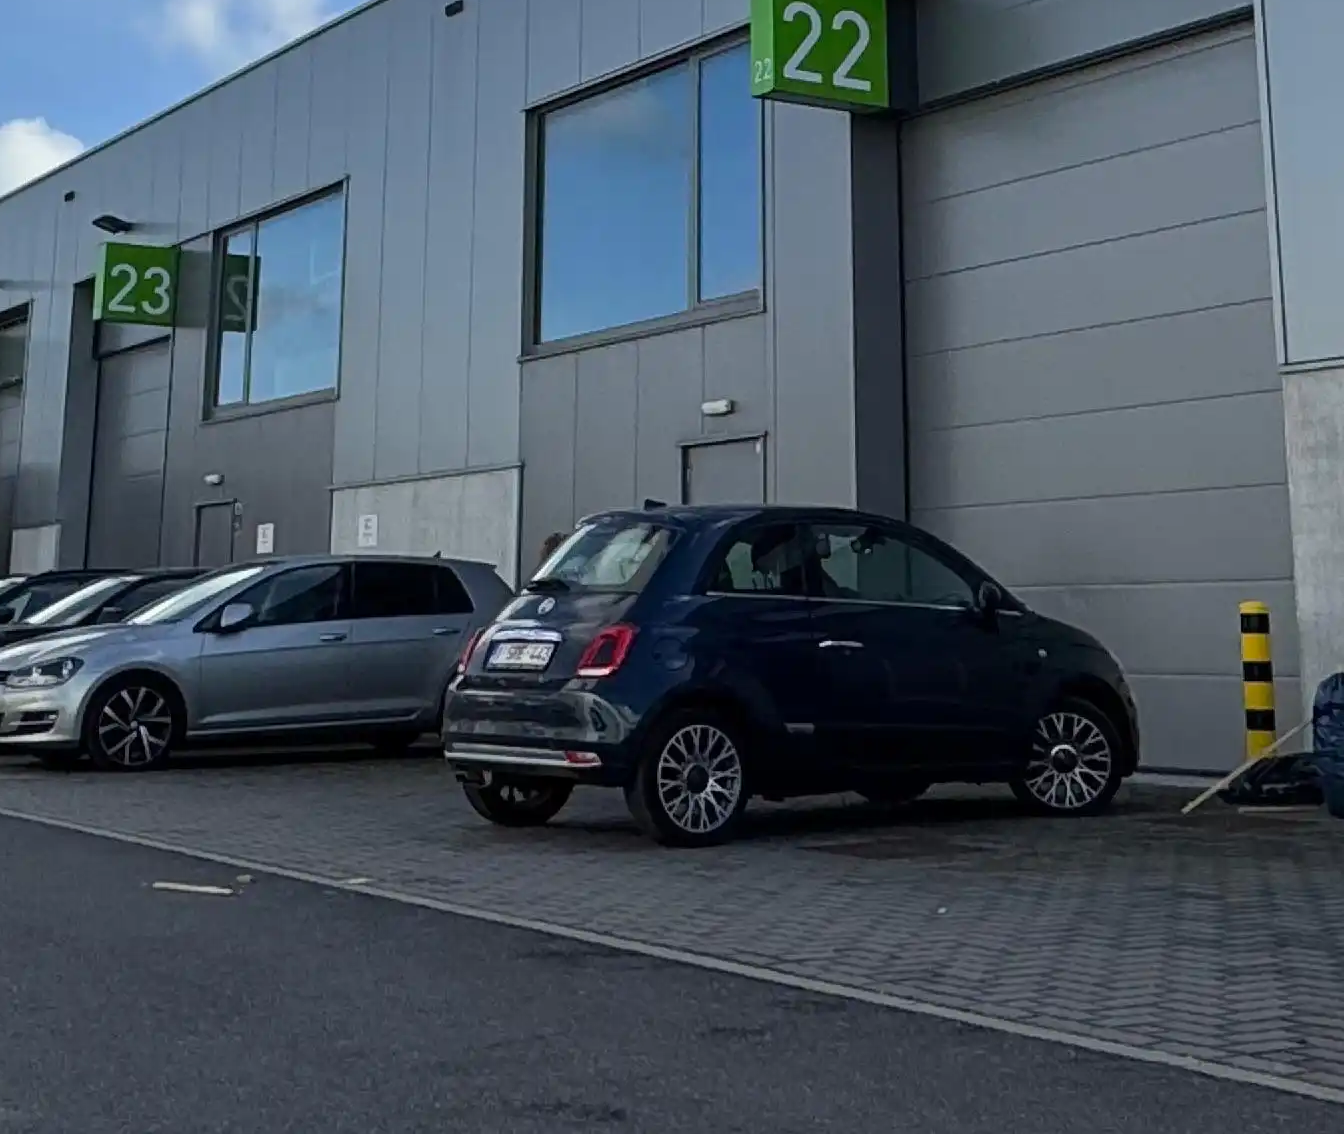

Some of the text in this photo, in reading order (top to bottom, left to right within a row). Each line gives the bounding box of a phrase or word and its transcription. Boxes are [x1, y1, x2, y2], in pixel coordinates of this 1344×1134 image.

[754, 57, 773, 84] 22
[782, 0, 872, 92] 22
[107, 263, 172, 316] 23
